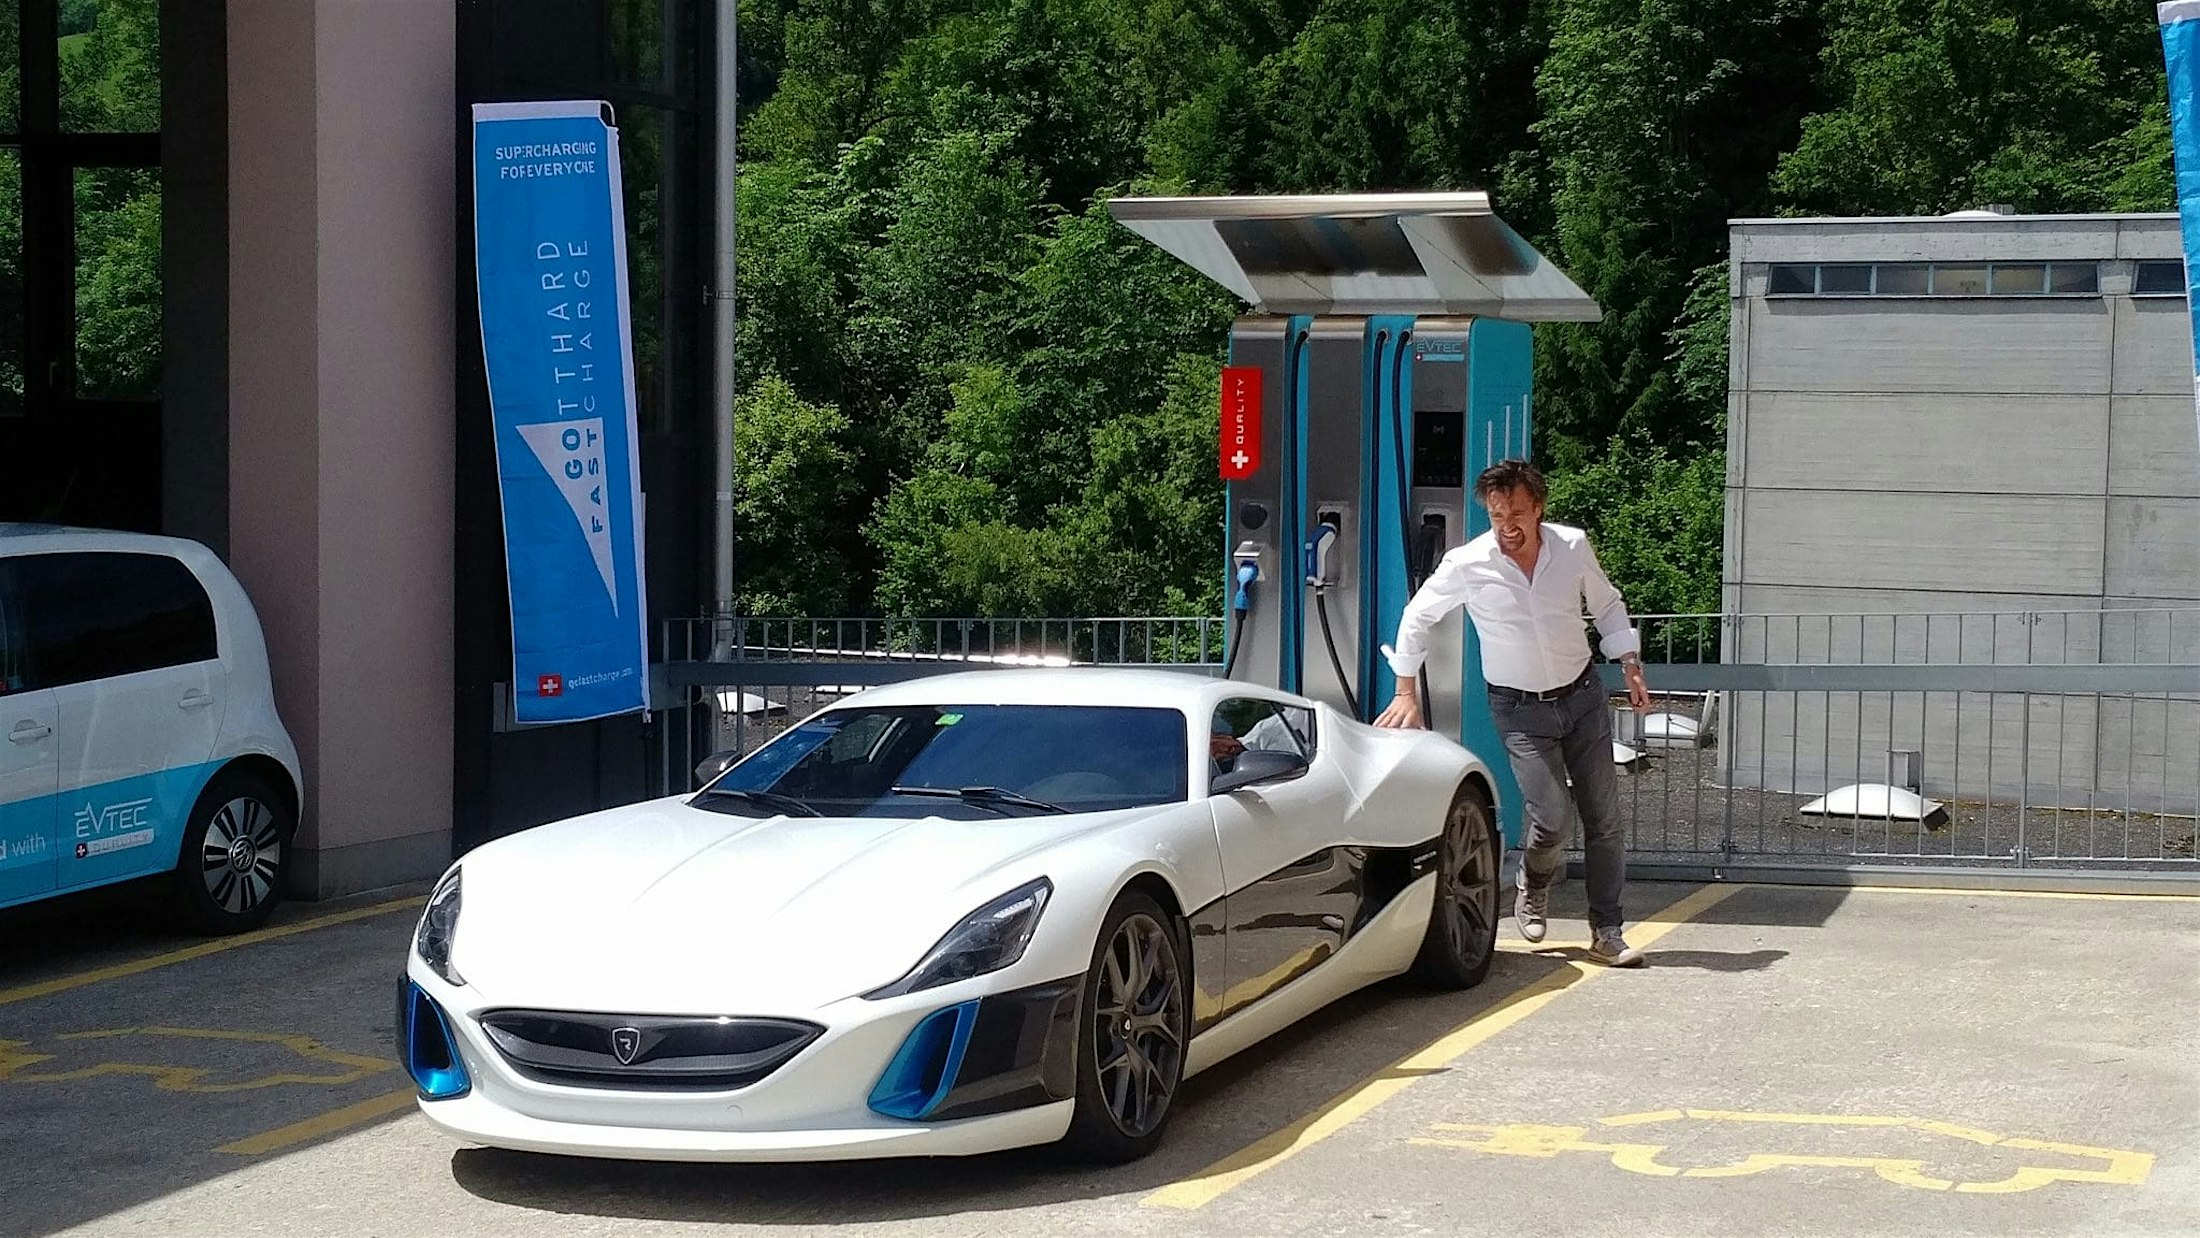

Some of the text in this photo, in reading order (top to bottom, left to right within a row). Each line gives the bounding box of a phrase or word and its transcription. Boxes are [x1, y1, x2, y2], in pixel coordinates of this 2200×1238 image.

[1235, 378, 1245, 445] QUALITY
[74, 799, 152, 838] EVTEC
[12, 832, 46, 857] with
